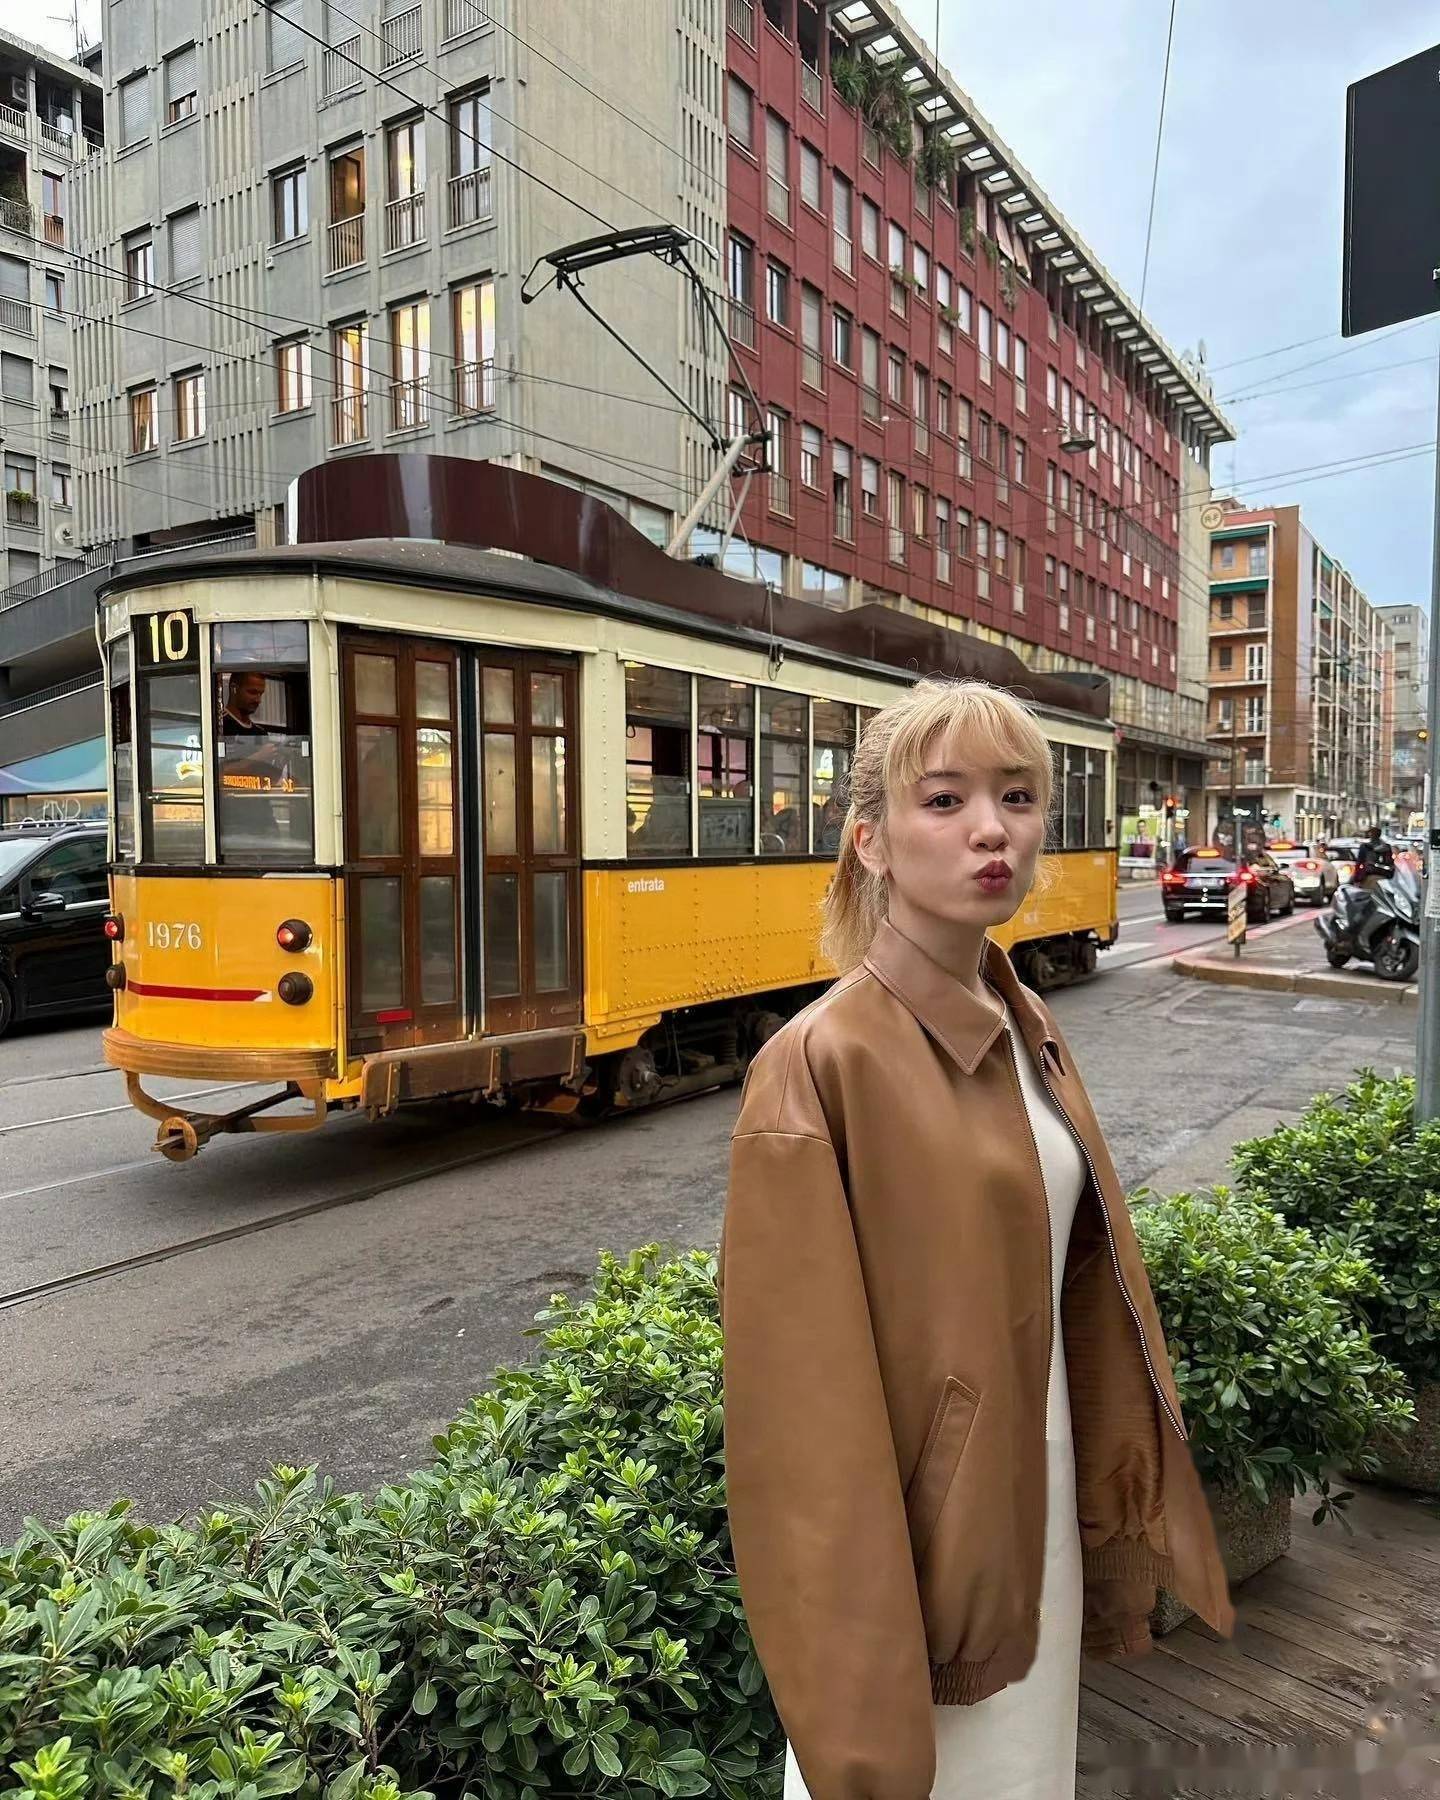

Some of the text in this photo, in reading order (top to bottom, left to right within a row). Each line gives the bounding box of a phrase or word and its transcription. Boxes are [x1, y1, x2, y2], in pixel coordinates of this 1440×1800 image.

[150, 611, 188, 662] 10
[628, 878, 665, 893] entrata
[147, 921, 202, 950] 1976
